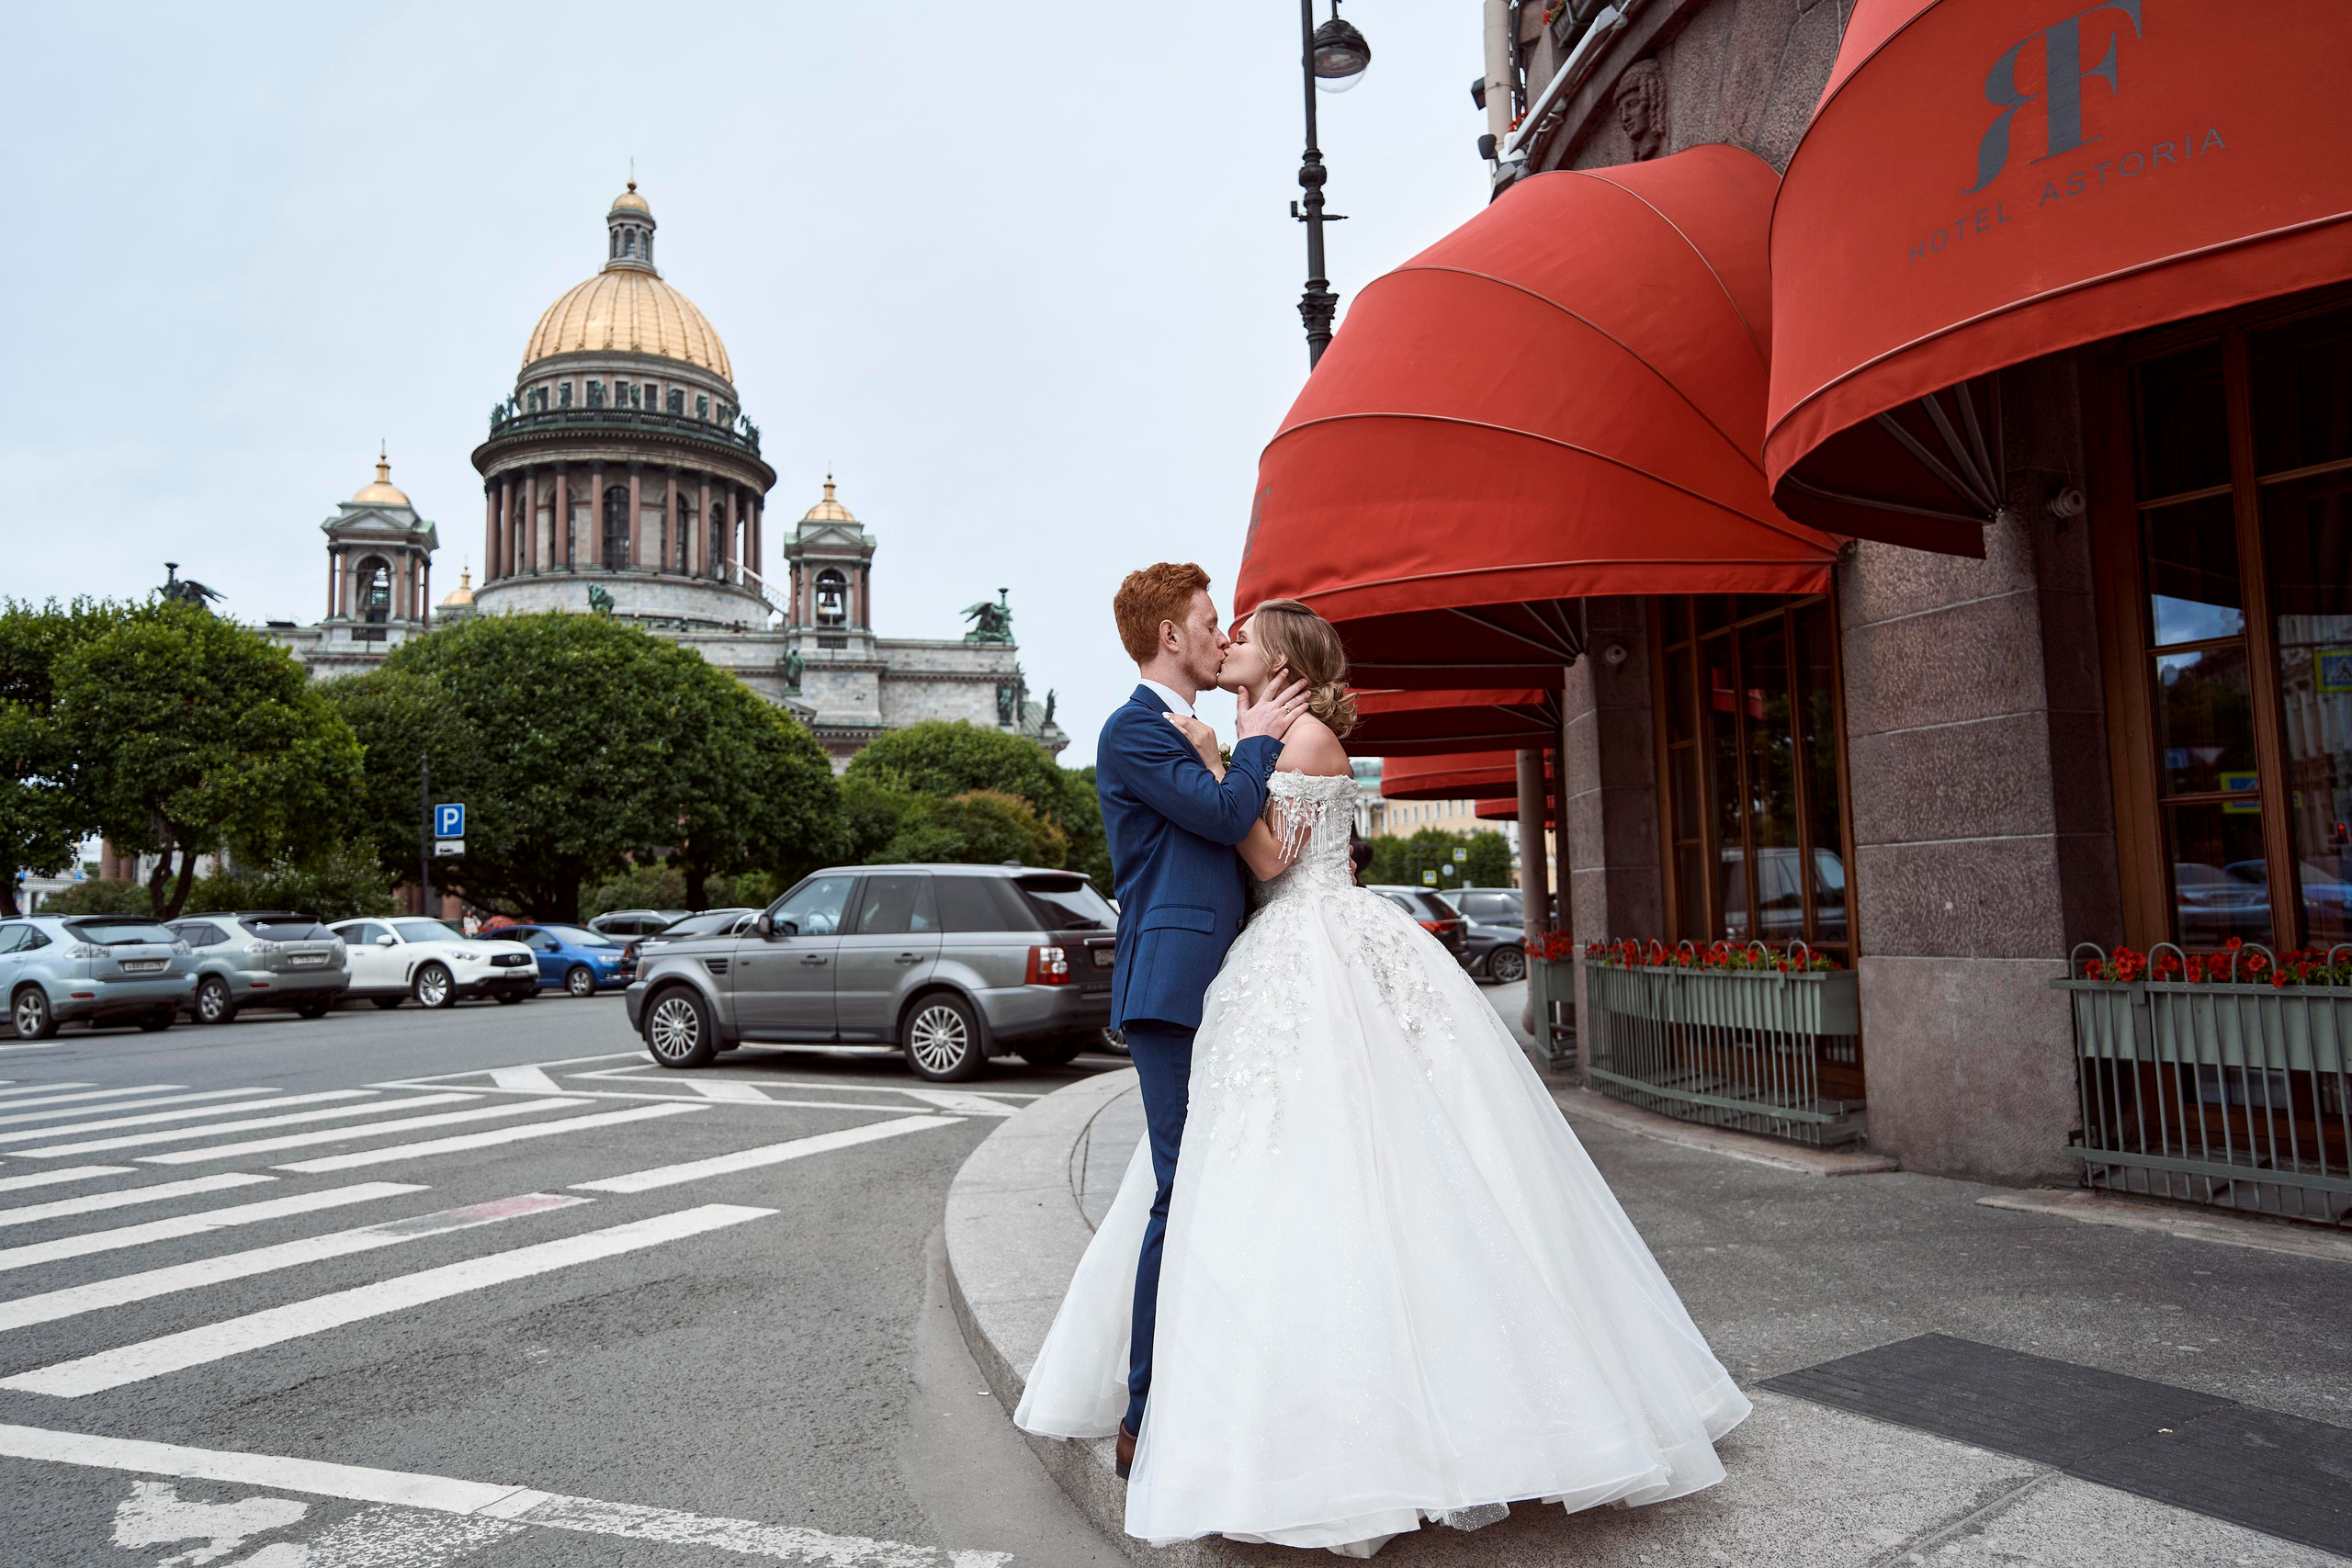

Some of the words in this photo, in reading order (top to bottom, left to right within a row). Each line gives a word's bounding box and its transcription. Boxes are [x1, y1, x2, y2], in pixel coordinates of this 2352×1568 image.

[1910, 201, 2013, 265] HOTEL
[2039, 128, 2227, 208] ASTORIA
[443, 807, 459, 834] P
